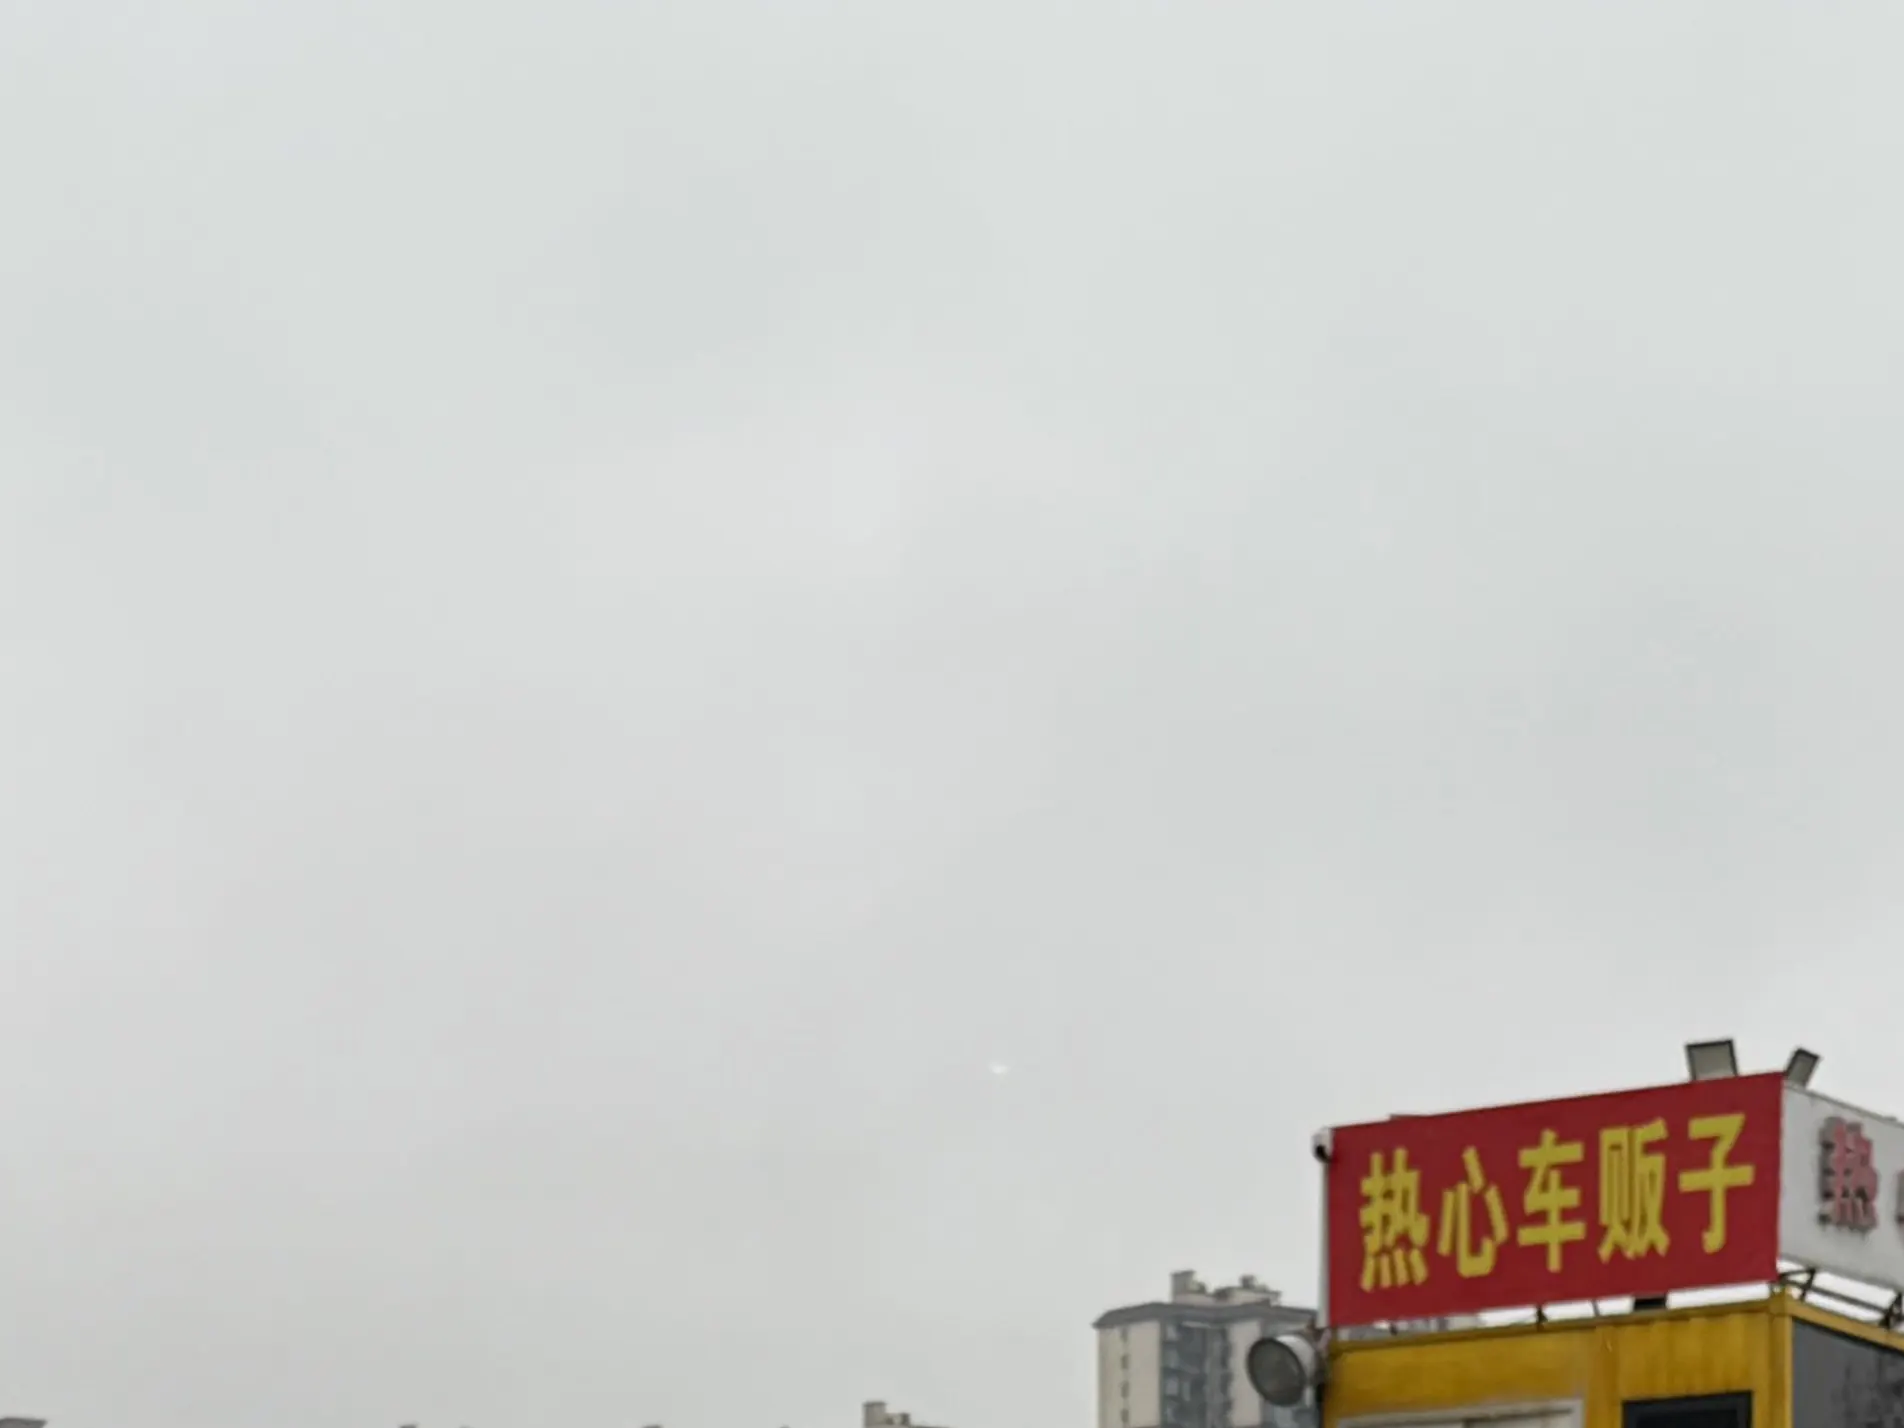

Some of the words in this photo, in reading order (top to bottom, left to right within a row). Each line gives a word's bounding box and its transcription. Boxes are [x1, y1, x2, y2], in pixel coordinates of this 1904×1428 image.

[1358, 1113, 1755, 1291] 热心车贩子
